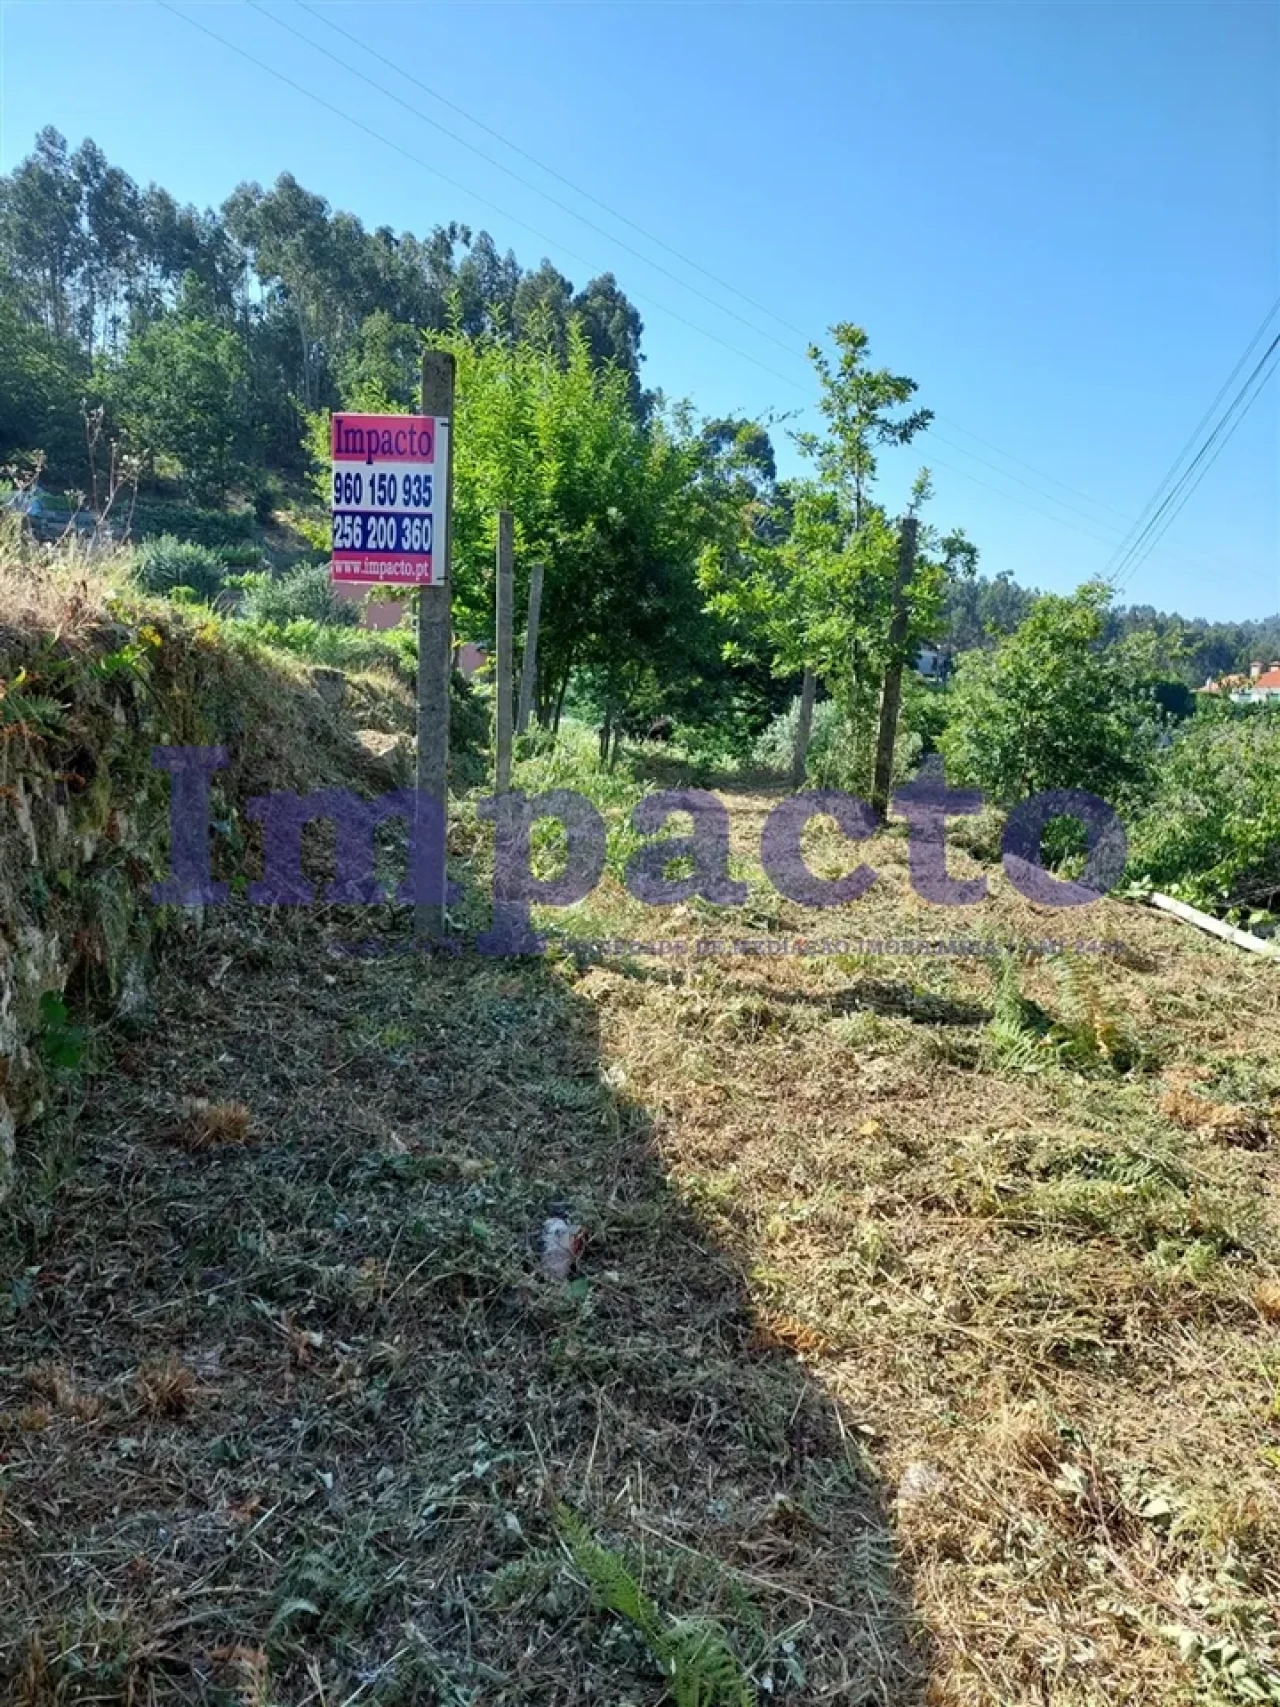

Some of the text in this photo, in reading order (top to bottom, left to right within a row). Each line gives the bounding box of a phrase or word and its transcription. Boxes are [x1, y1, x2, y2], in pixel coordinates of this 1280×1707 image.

[335, 419, 431, 464] Impacto
[334, 472, 432, 508] 960 150 935
[334, 515, 431, 551] 256 200 360
[334, 557, 428, 580] www.impacto.pt
